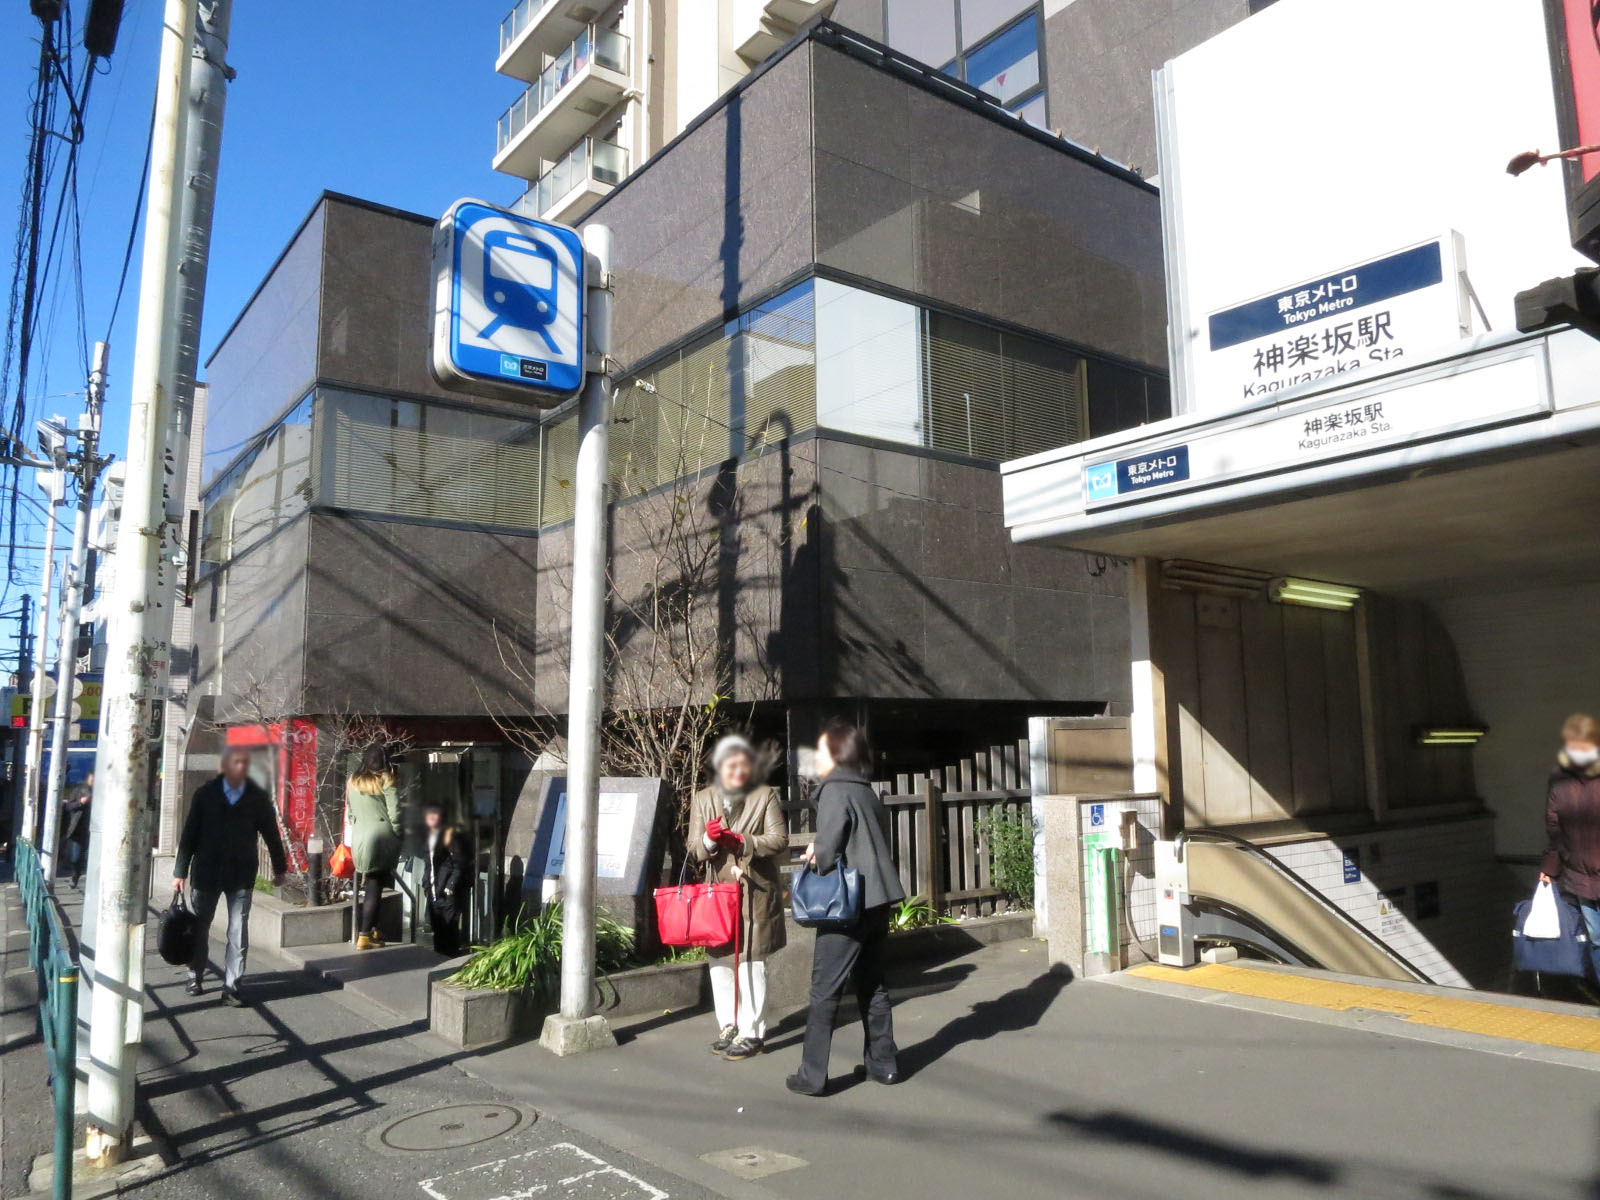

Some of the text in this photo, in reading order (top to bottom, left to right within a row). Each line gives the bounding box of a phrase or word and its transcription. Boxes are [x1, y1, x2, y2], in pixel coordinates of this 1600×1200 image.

[1277, 275, 1358, 313] 東京メトロ
[1283, 296, 1354, 325] Tokyo Metro
[1253, 311, 1394, 377] 神楽坂駅
[1303, 402, 1384, 435] 神楽坂駅
[1298, 422, 1393, 450] Kagurazaka Sta.
[1127, 456, 1177, 476] 東京メトロ
[1131, 469, 1174, 485] Tokyo Metro
